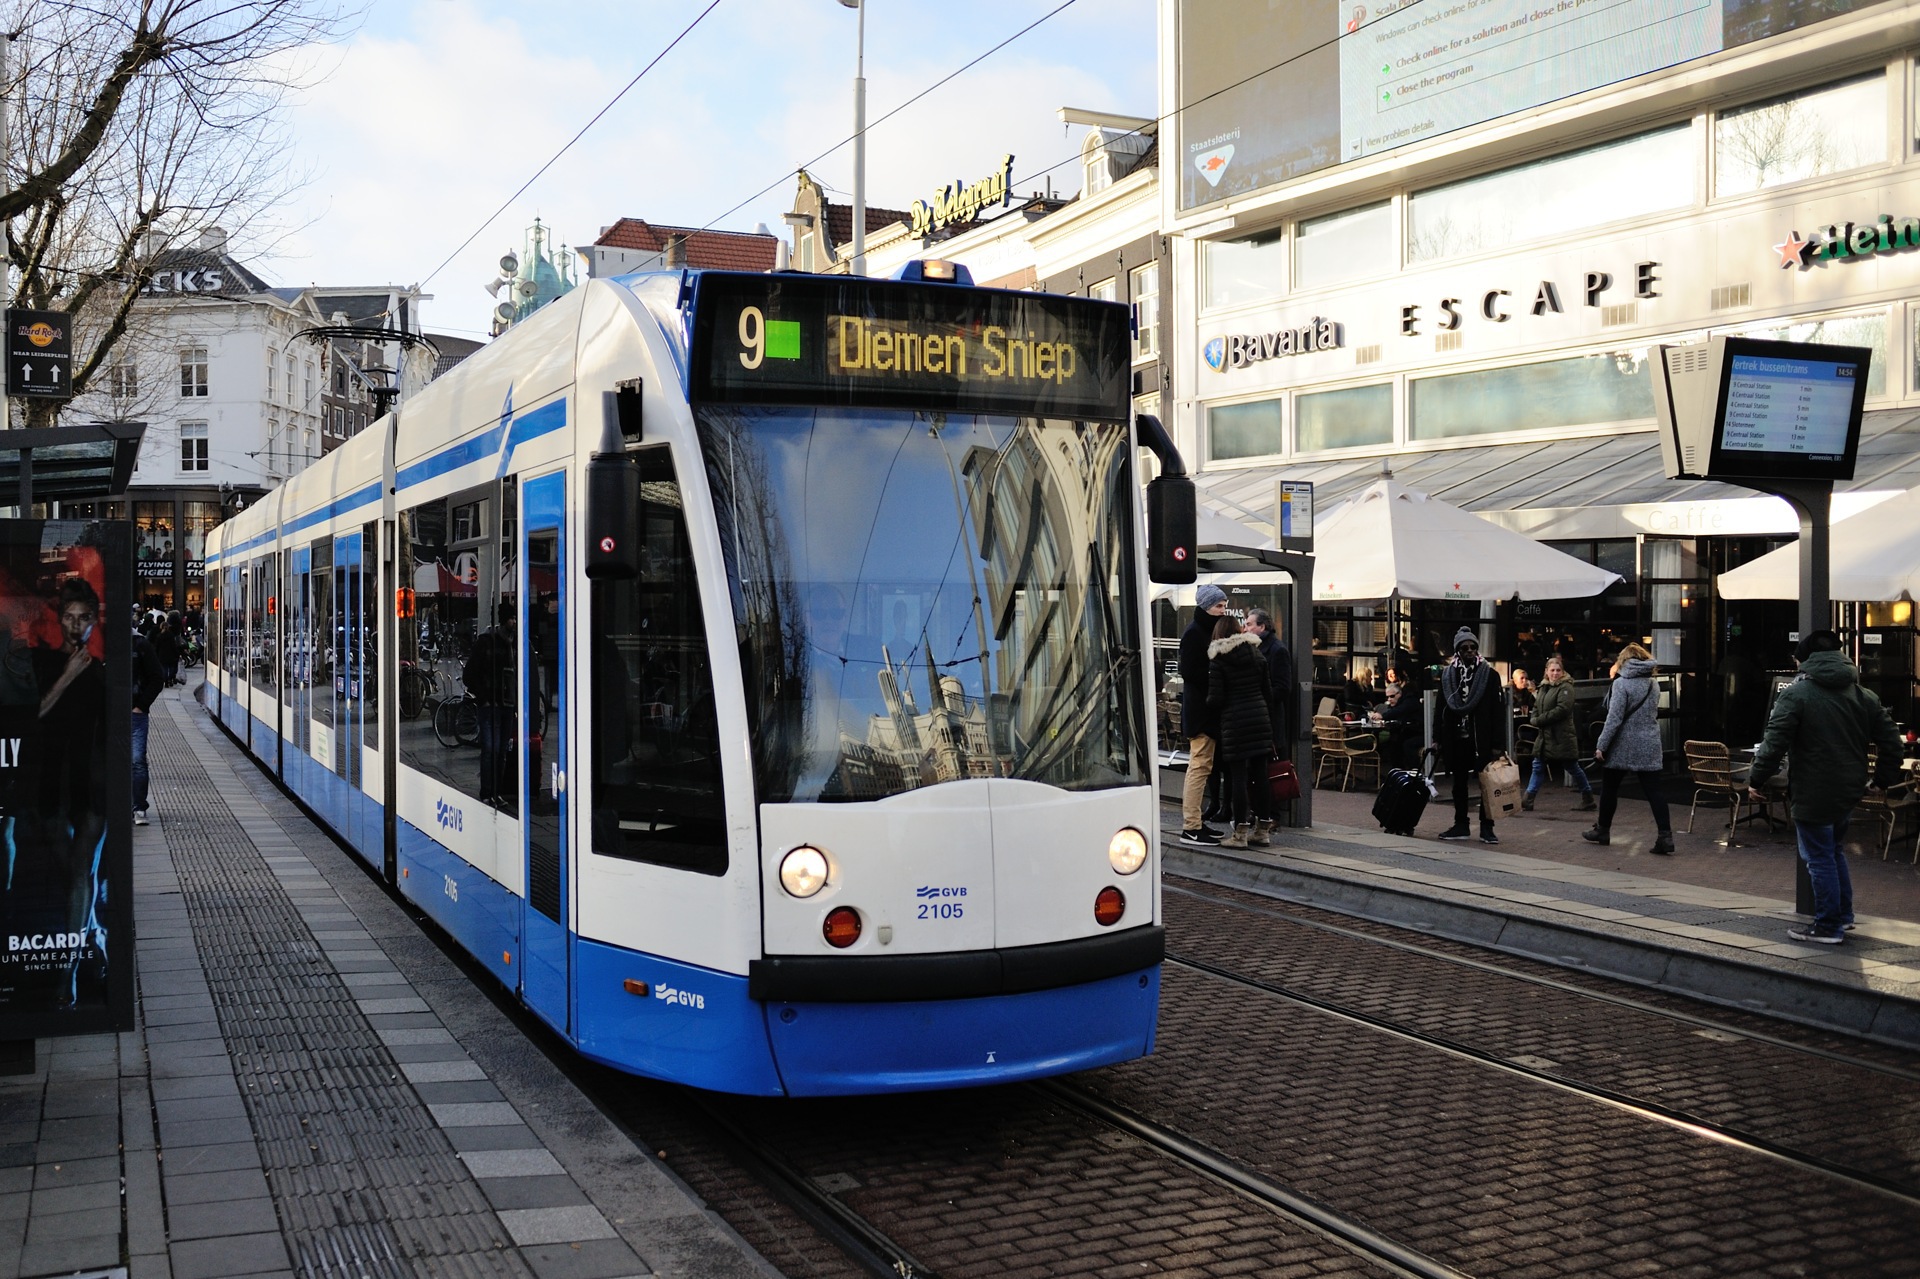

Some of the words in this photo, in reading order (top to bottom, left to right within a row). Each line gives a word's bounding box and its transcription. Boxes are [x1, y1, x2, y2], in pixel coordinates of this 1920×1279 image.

[1375, 27, 1406, 43] Windows
[1407, 21, 1420, 31] can
[1422, 13, 1442, 27] check
[1444, 4, 1466, 18] online
[1396, 52, 1421, 68] Check
[1423, 44, 1448, 59] online
[1450, 38, 1463, 50] for
[1472, 23, 1508, 42] solution
[1510, 14, 1528, 29] and
[1530, 7, 1555, 21] close
[1557, 1, 1573, 12] the
[1396, 83, 1419, 96] Close
[1420, 77, 1435, 88] the
[1436, 64, 1474, 85] program
[1190, 126, 1241, 153] Staatsloterij
[1366, 135, 1381, 147] View
[1382, 125, 1411, 144] problem
[1411, 119, 1435, 133] details
[1817, 213, 1920, 262] Hein
[1399, 260, 1663, 338] ESCAPE
[18, 325, 40, 336] Hard
[41, 327, 63, 339] Rock
[738, 306, 765, 370] 9
[839, 315, 966, 375] Diemen
[983, 325, 1076, 385] Sniep
[1227, 316, 1344, 369] Bavaria
[1760, 360, 1808, 374] bussen/trams
[1838, 367, 1853, 377] 14:54
[1737, 381, 1755, 389] Centraal
[1756, 382, 1772, 390] Station
[448, 805, 463, 832] GVB
[942, 887, 968, 898] GVB
[917, 904, 964, 919] 2105
[2, 951, 94, 963] UNTAMEABLE
[24, 963, 51, 971] SINCE
[678, 990, 705, 1009] GVB
